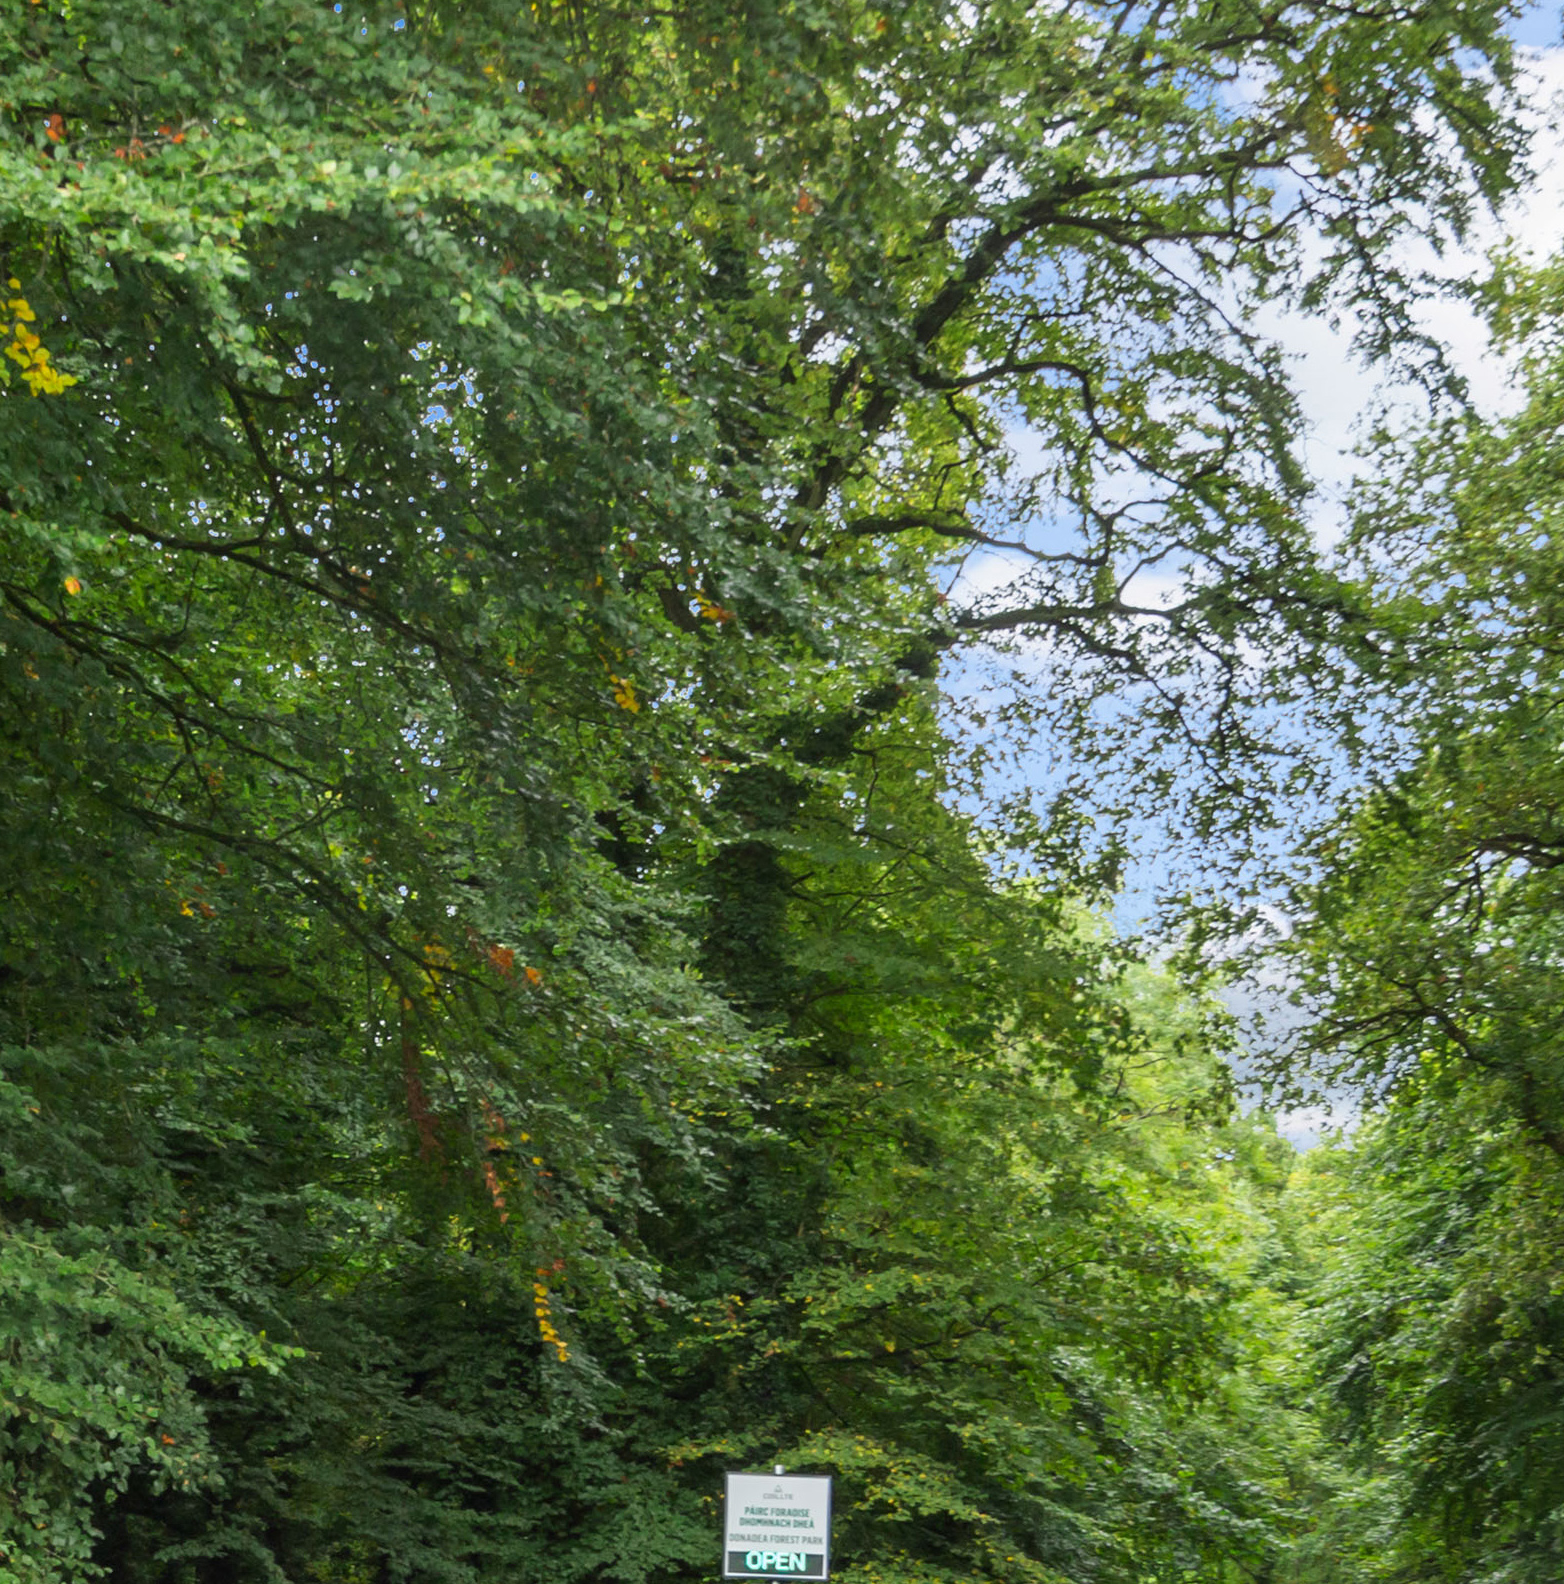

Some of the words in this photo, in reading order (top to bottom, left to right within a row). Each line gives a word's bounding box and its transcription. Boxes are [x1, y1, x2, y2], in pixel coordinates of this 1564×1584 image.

[744, 1504, 769, 1516] PÁIRC
[728, 1533, 768, 1543] DONADEA
[769, 1534, 800, 1545] FOREST
[801, 1536, 824, 1546] PARK
[745, 1550, 807, 1572] OPEN
